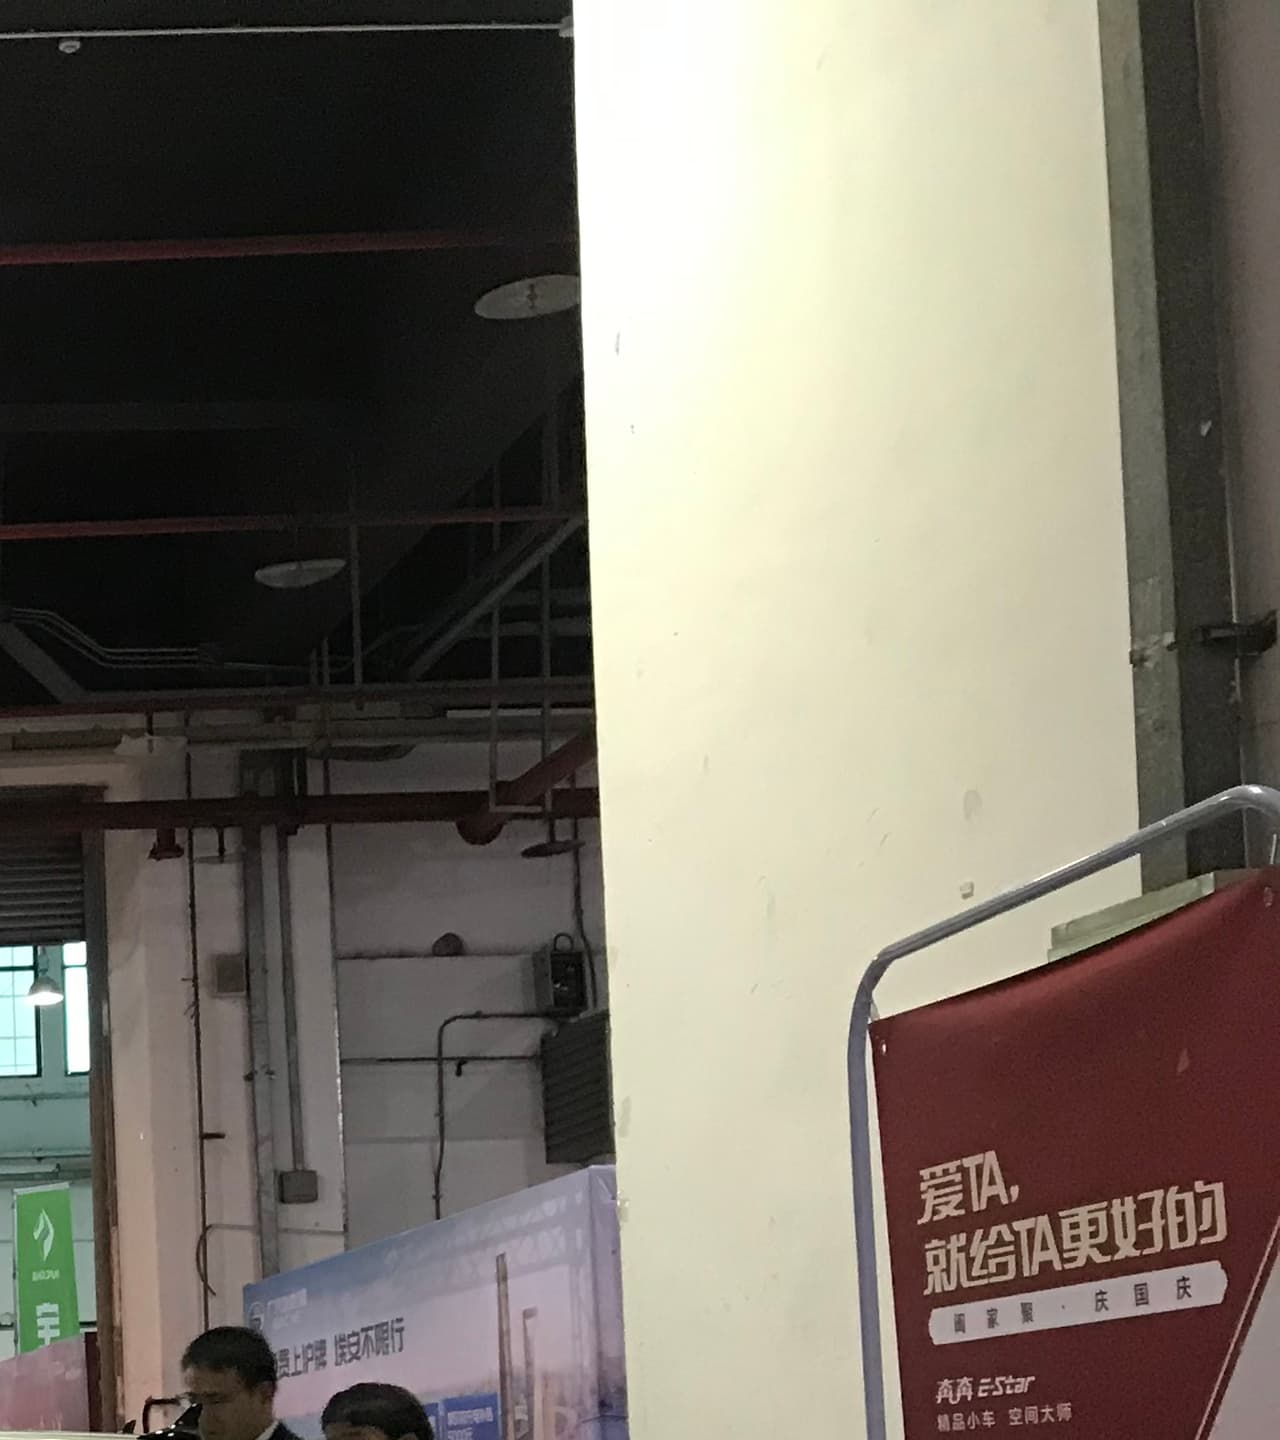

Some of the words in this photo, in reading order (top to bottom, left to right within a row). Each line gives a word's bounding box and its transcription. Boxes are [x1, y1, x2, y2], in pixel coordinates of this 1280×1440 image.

[923, 1180, 1228, 1296] 就给TA更好的
[275, 1339, 327, 1379] 费上沪牌
[937, 1409, 996, 1432] 精品小车
[1008, 1402, 1073, 1426] 空间大师
